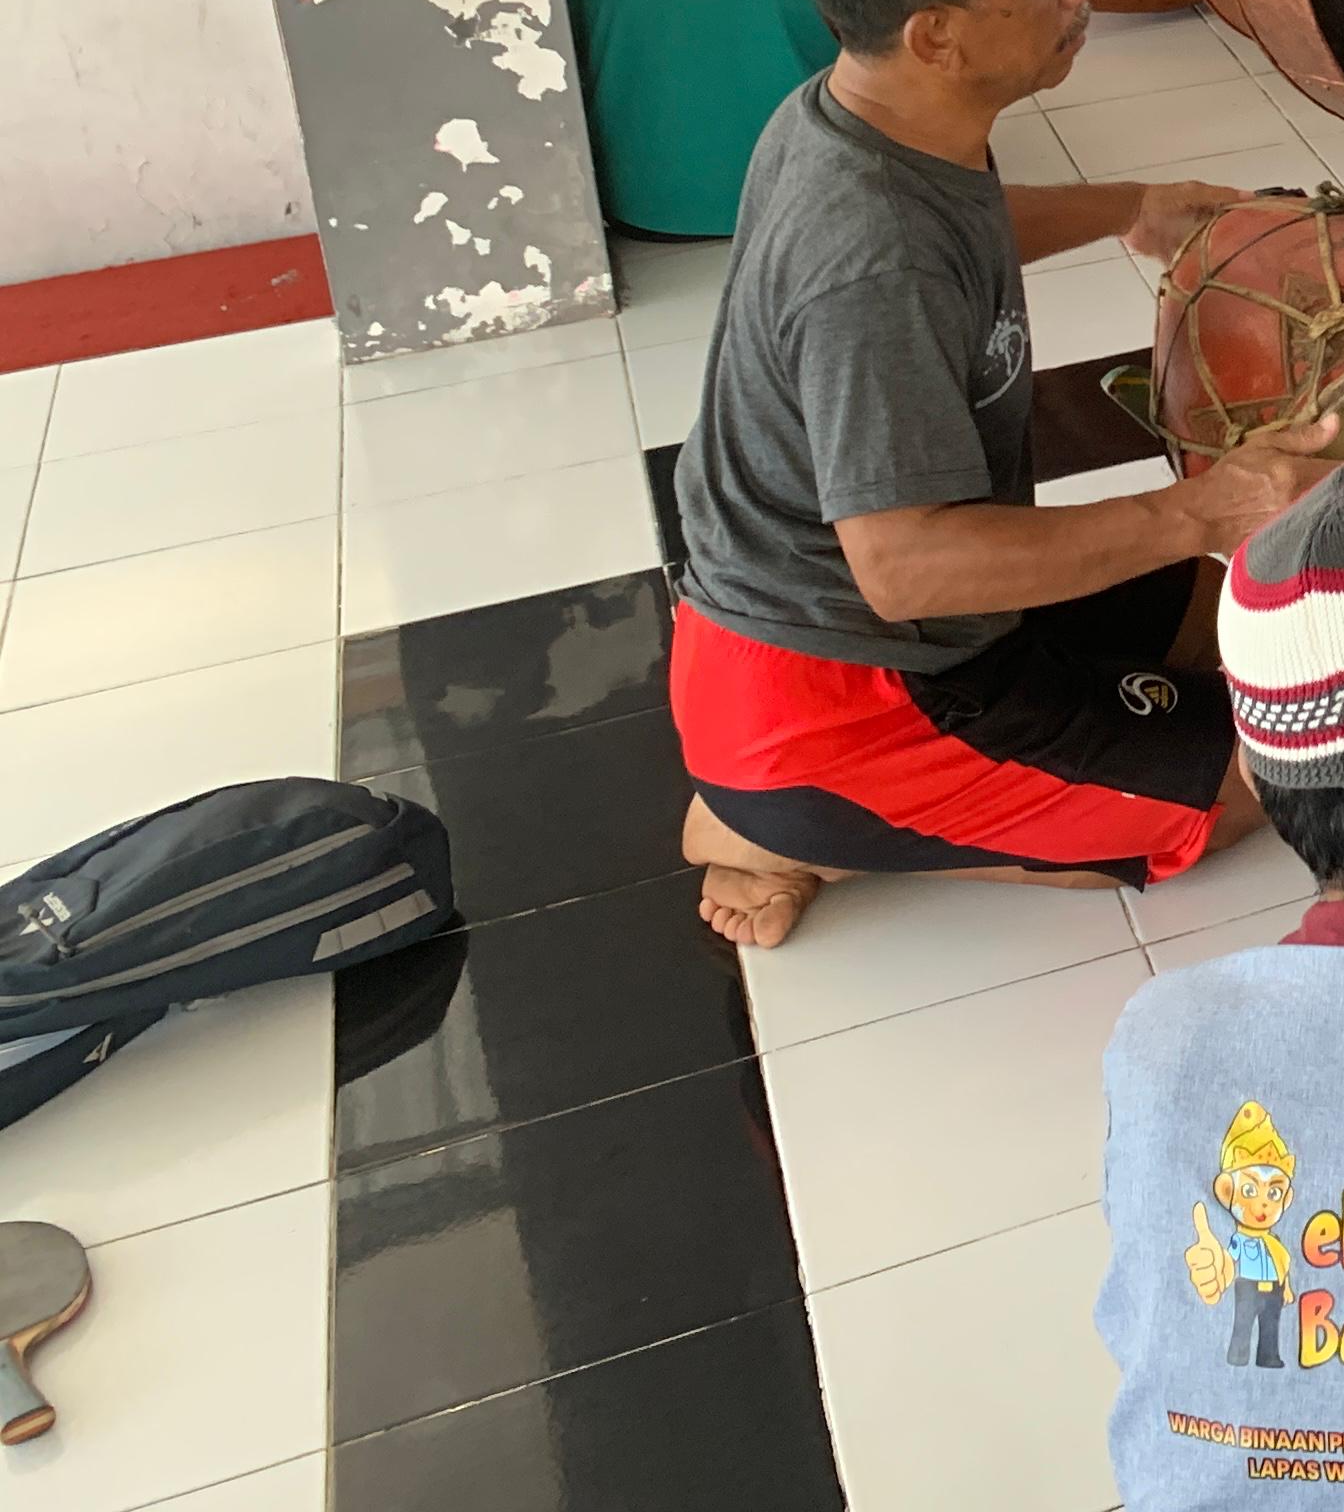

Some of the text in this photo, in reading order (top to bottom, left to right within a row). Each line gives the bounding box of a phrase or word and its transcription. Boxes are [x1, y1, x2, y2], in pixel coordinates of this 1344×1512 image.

[1167, 1410, 1237, 1449] WARGA
[1239, 1425, 1327, 1454] BINAAN
[1247, 1458, 1320, 1481] LAPAS
